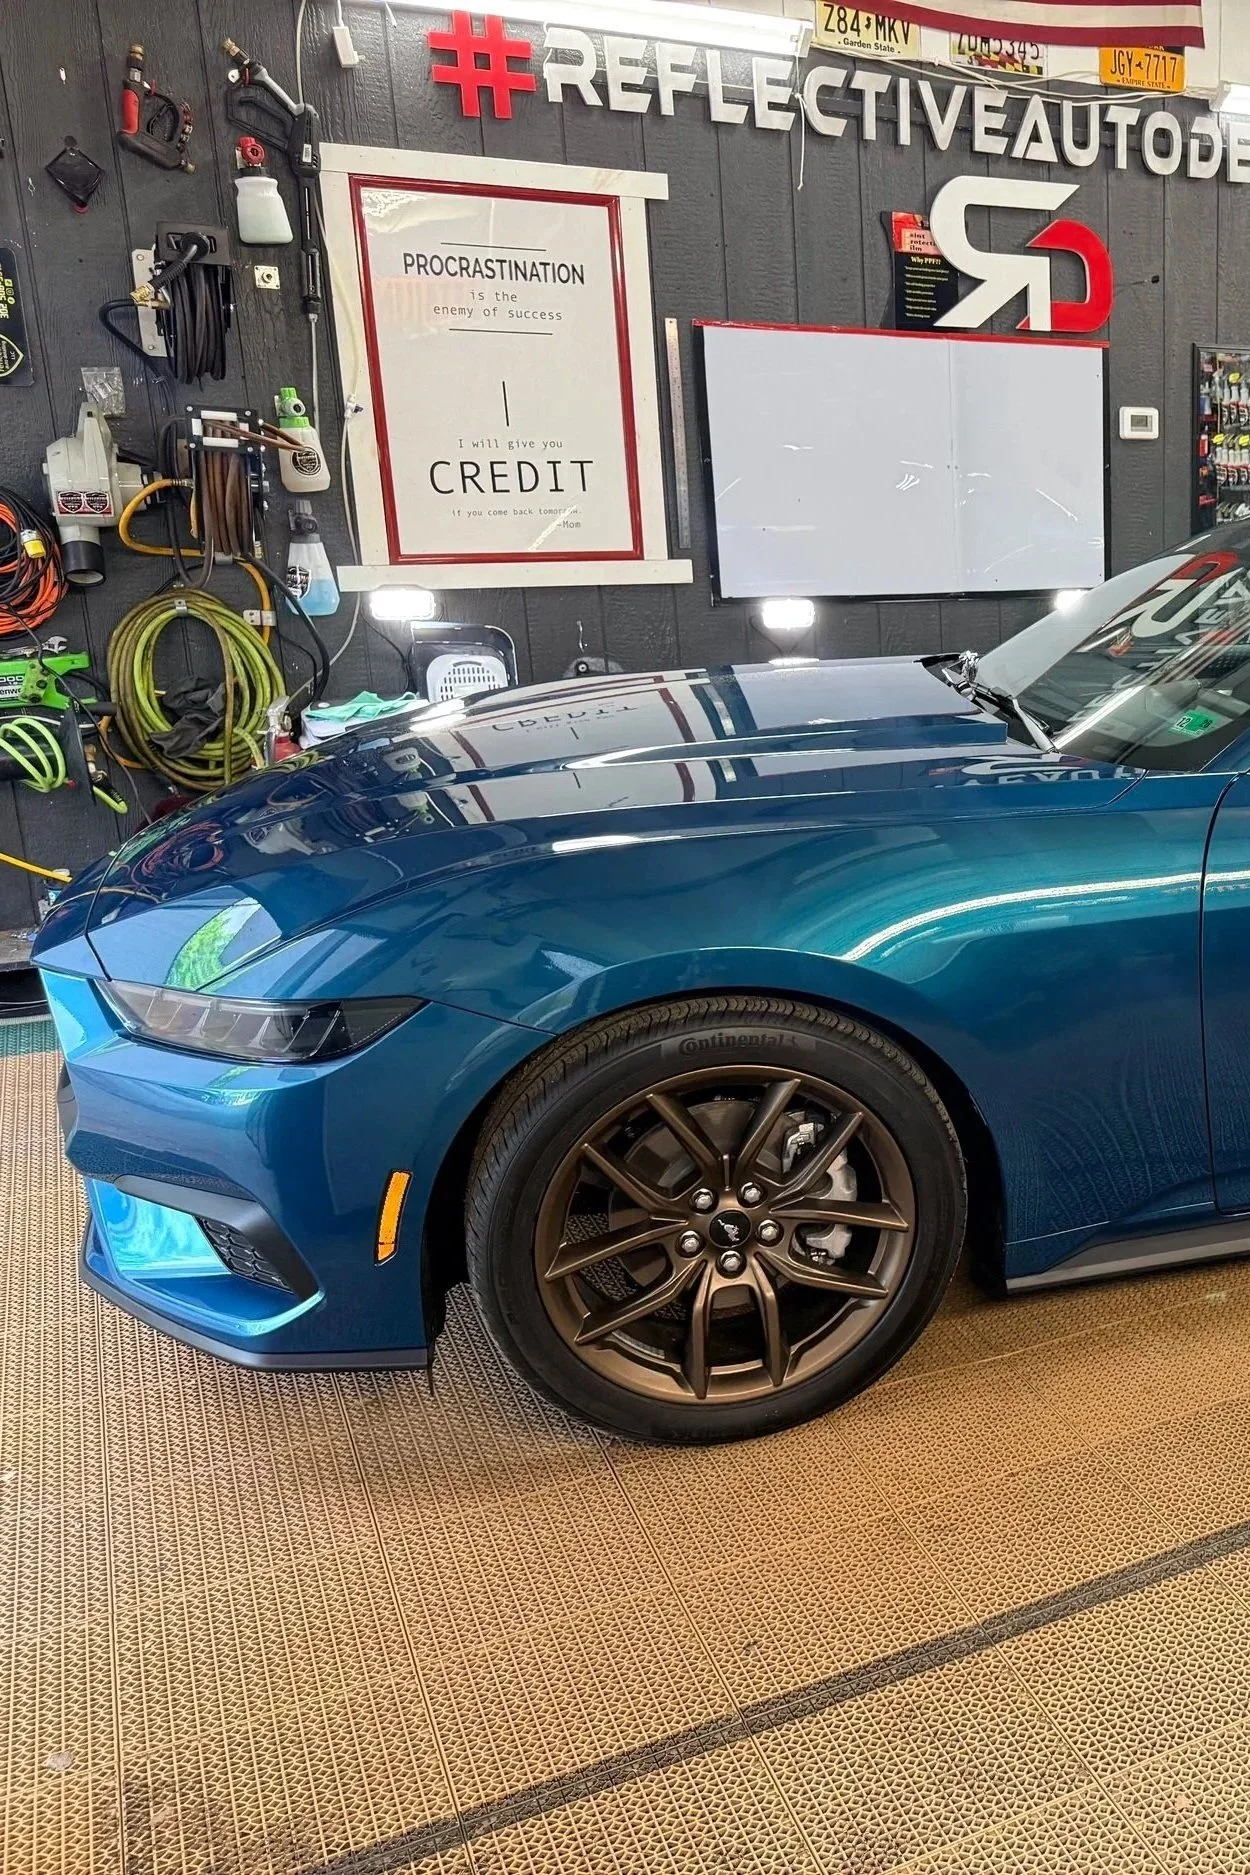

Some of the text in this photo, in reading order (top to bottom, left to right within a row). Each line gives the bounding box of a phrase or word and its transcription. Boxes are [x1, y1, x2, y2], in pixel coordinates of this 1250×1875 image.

[824, 3, 910, 45] Z84 MKV
[843, 37, 895, 53] Garden State
[1110, 49, 1177, 83] JGY 7717
[1122, 77, 1166, 89] EMPIRE STATE
[911, 256, 924, 265] Why
[402, 252, 586, 286] PROCRASTINATION
[470, 290, 518, 302] is the
[433, 305, 563, 321] enemy of success
[458, 439, 564, 450] I will give you
[429, 460, 593, 494] CREDIT
[452, 509, 462, 517] if
[467, 508, 483, 518] you
[513, 508, 533, 516] back
[1176, 717, 1191, 732] 12
[678, 1032, 785, 1056] Continental
